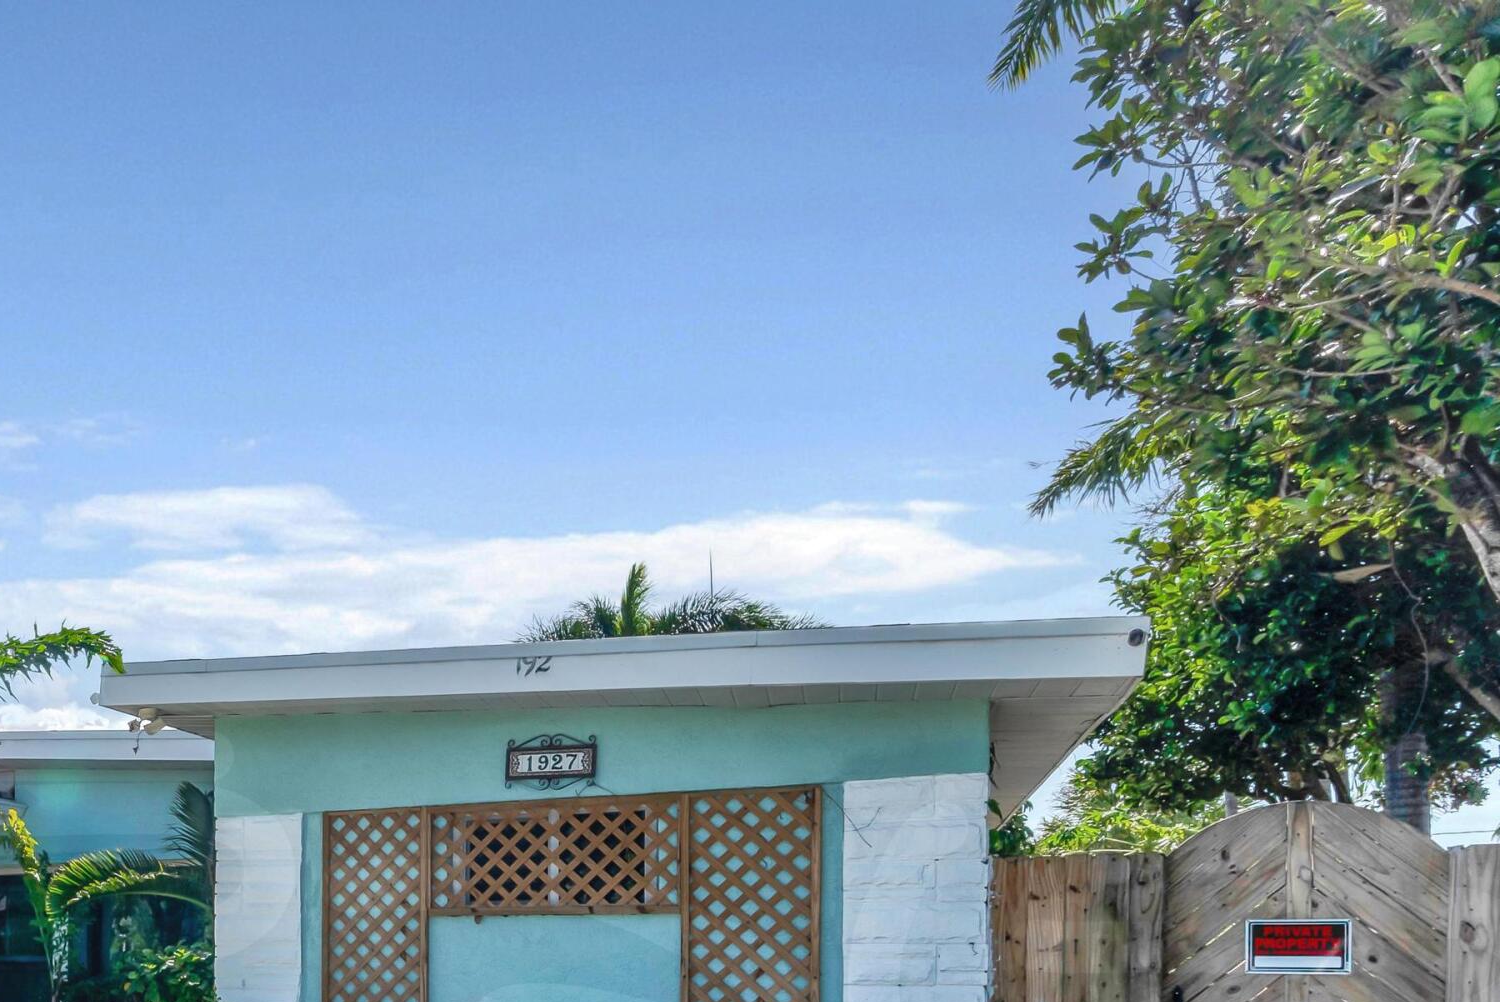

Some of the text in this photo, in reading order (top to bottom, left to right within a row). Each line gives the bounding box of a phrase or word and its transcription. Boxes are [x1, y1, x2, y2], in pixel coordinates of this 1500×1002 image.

[527, 753, 577, 772] 1927
[1263, 925, 1333, 937] PRIVATE
[1254, 937, 1342, 951] PROPERTY
